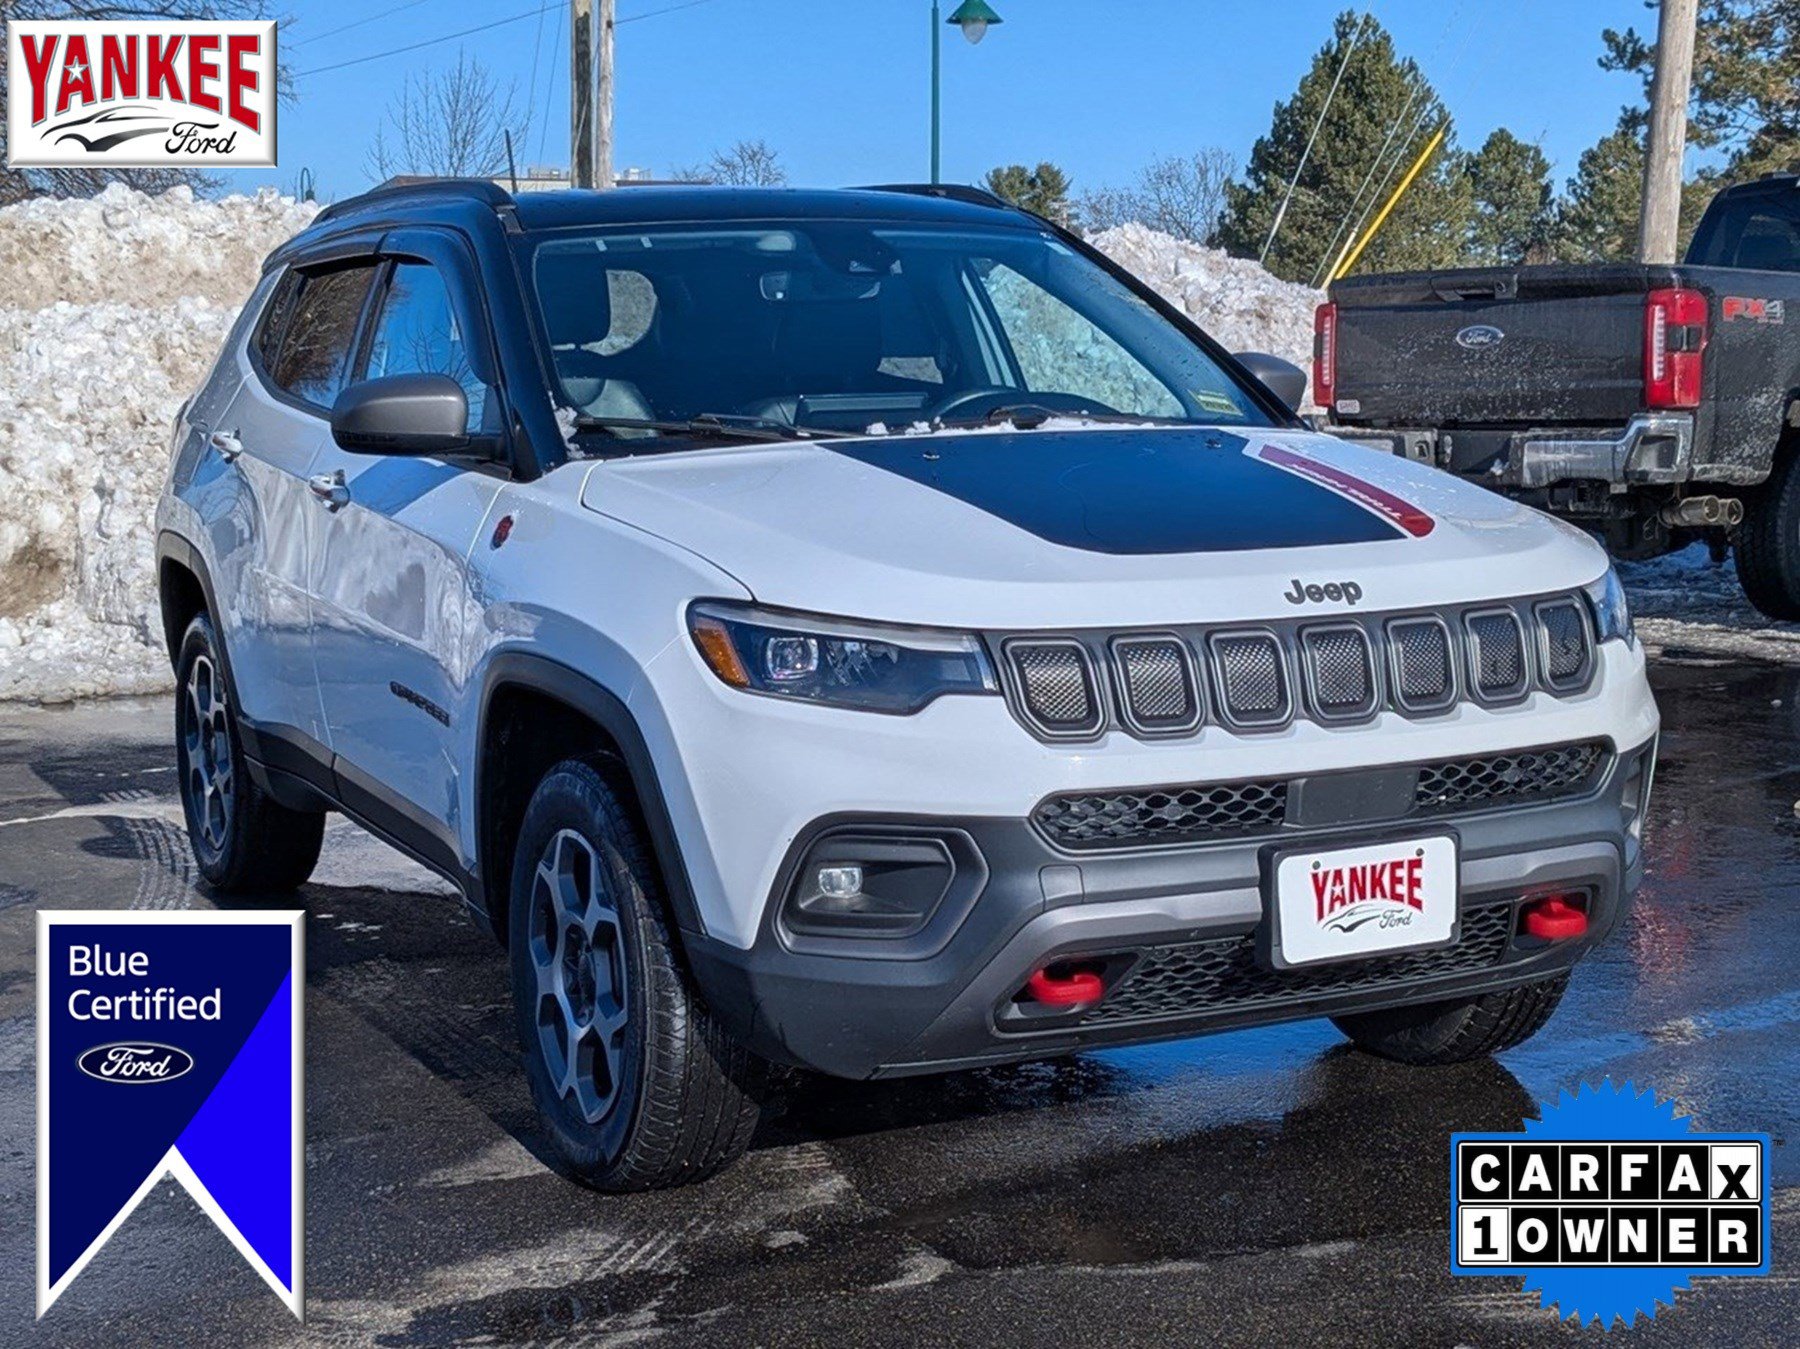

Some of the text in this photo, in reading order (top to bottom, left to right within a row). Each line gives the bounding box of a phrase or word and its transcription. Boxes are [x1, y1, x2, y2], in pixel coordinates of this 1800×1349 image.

[1723, 296, 1785, 323] FX4
[1283, 579, 1363, 606] Jeep
[1311, 857, 1424, 923] YANKEE
[1378, 908, 1413, 930] Ford
